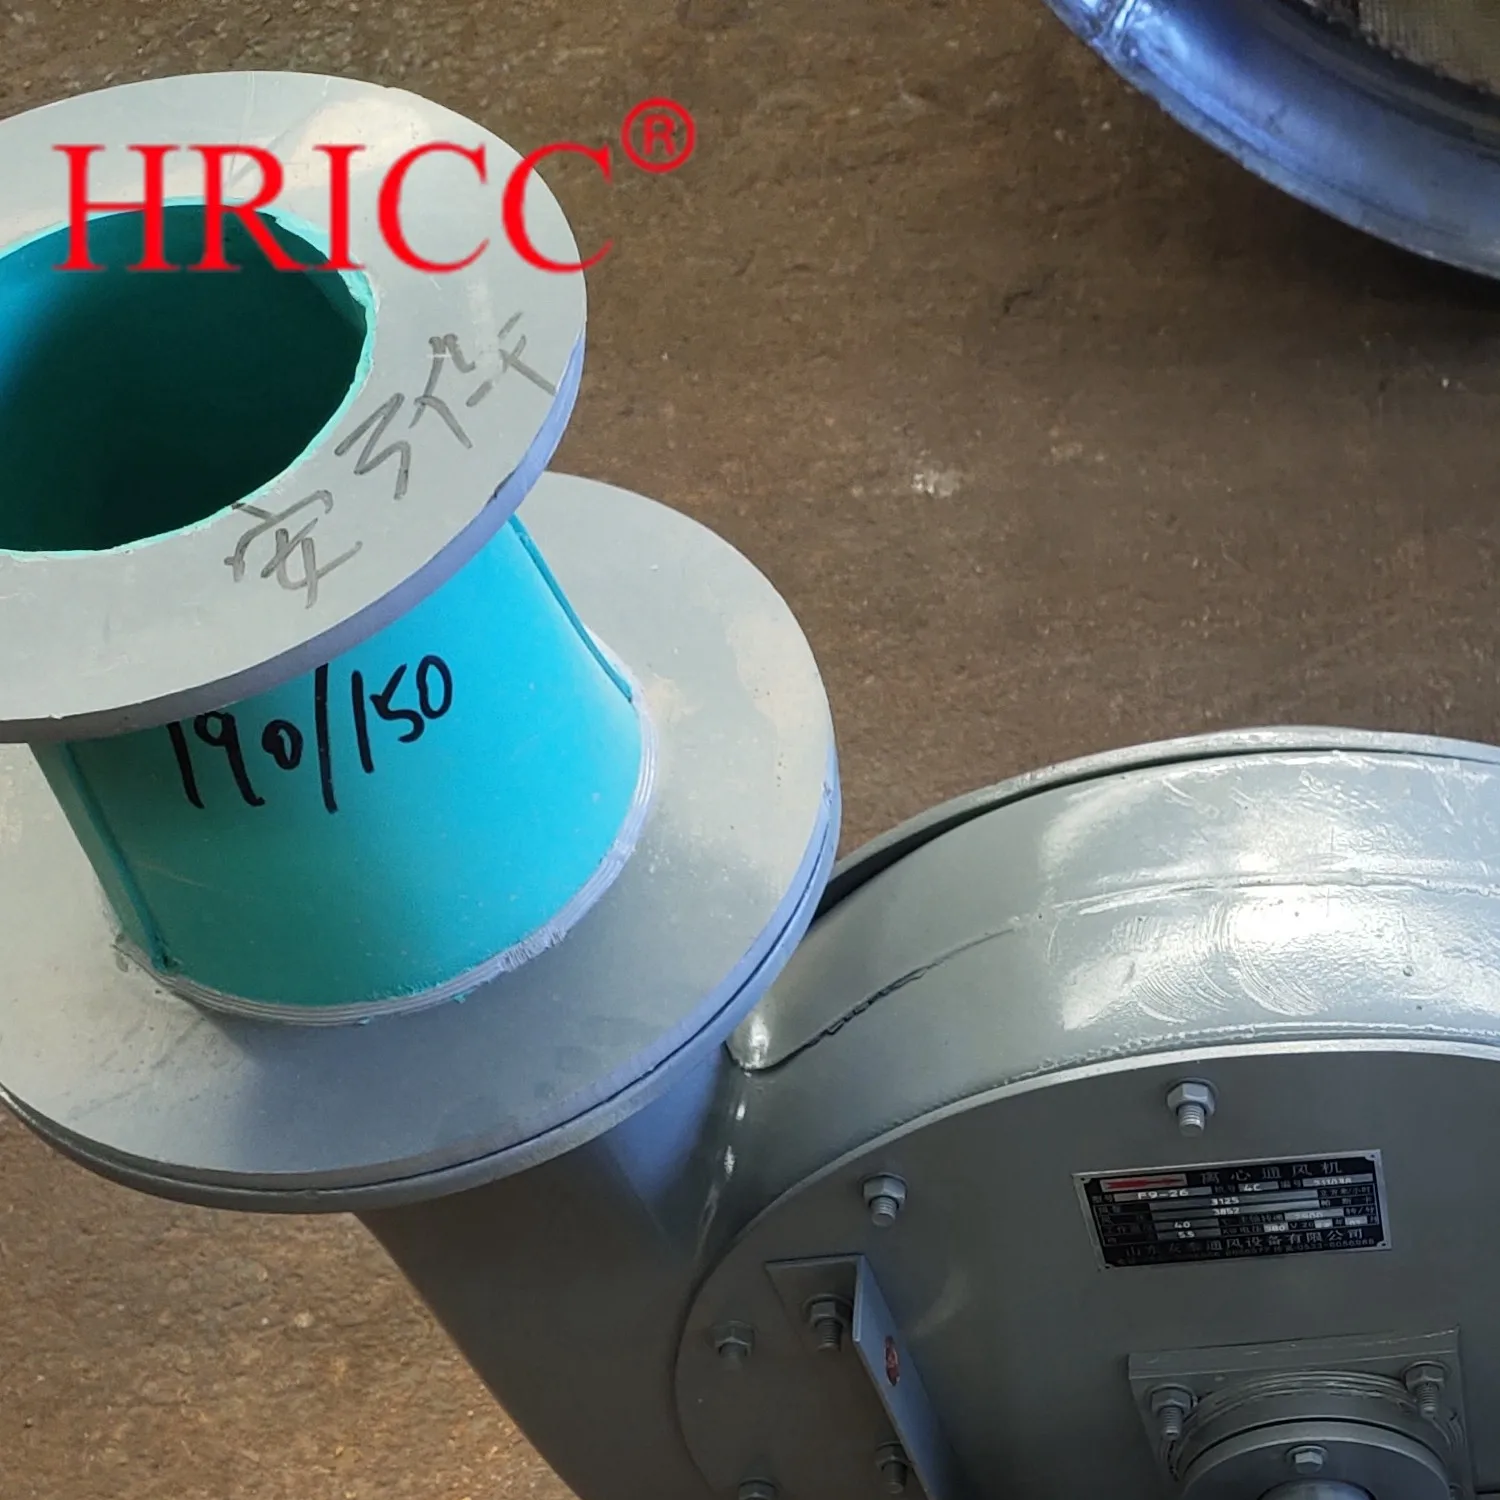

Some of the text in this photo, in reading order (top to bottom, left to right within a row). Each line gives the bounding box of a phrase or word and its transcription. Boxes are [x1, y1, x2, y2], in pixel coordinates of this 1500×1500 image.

[165, 654, 454, 814] 190/150
[1199, 1161, 1341, 1183] 离心通风机
[1210, 1196, 1240, 1206] 3125
[1212, 1206, 1240, 1216] 3852
